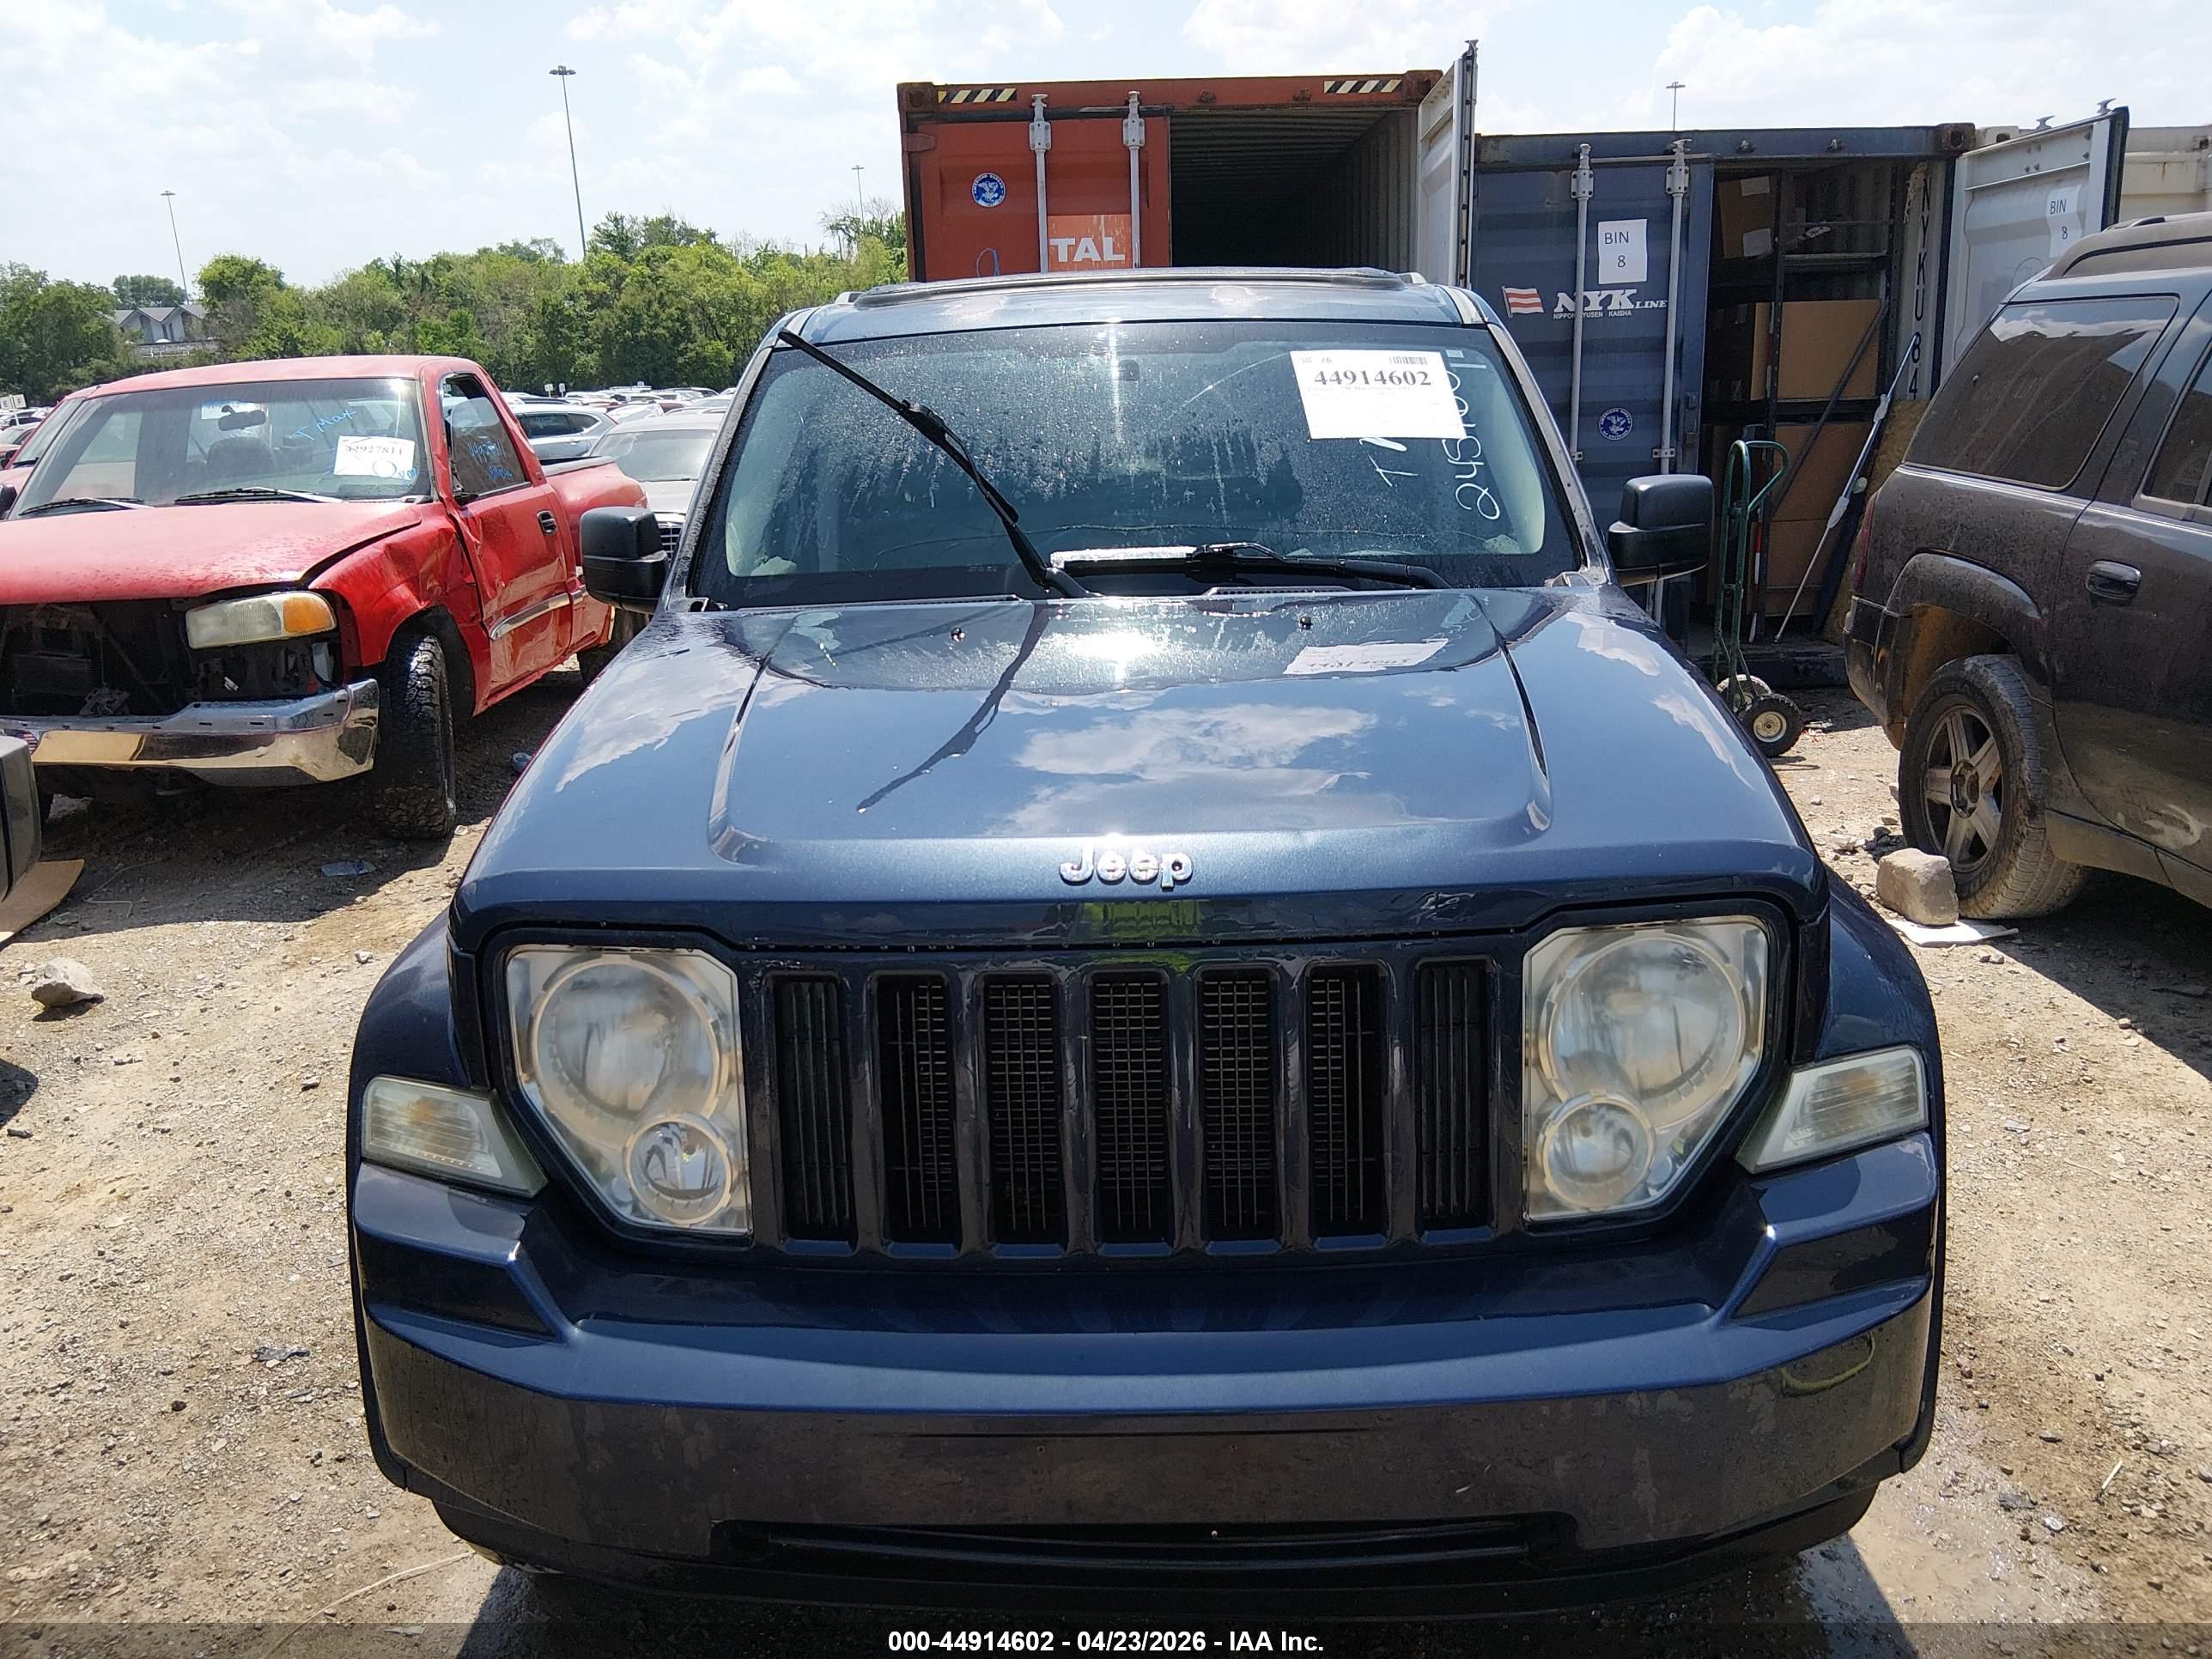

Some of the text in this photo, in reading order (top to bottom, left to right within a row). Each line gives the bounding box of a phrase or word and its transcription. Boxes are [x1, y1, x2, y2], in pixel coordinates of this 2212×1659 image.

[2050, 198, 2067, 215] BIN
[1604, 231, 1629, 245] BIN
[2061, 226, 2068, 240] 8
[1050, 236, 1126, 262] TAL
[1915, 175, 1931, 322] NYKU
[1617, 255, 1626, 268] 8
[1553, 289, 1668, 313] NYK LINE
[1314, 369, 1431, 386] 44914602
[1059, 844, 1194, 891] Jeep
